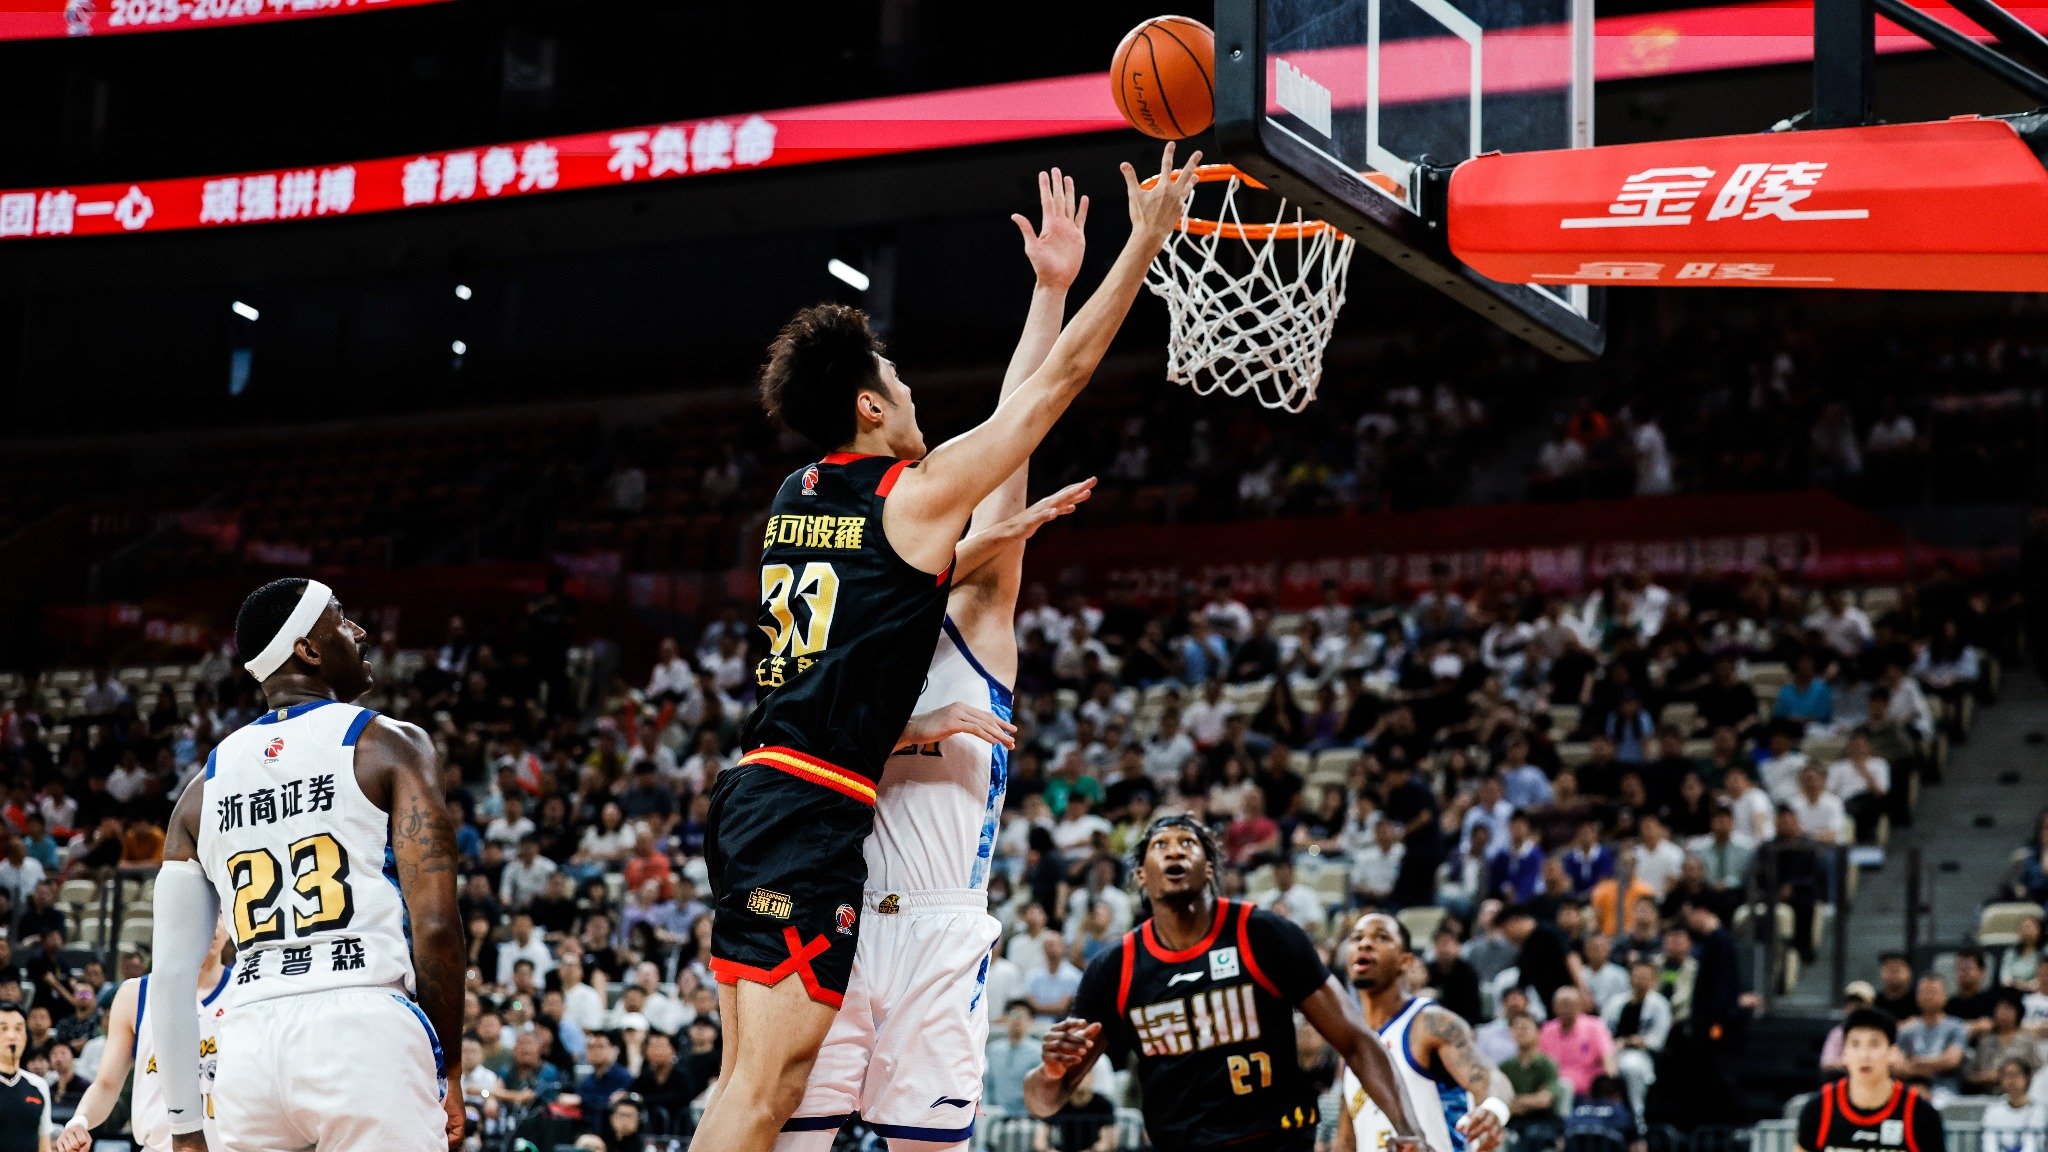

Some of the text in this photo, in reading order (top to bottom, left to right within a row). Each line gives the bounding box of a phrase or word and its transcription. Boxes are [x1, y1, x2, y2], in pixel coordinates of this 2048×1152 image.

[0, 114, 777, 236] 团结一心 顽强拼搏 奋勇争先 不负使命
[1560, 161, 1869, 229] 金陵
[217, 773, 336, 834] 浙商证券
[227, 832, 355, 951] 23
[1129, 984, 1260, 1056] 深圳
[1227, 1051, 1272, 1095] 27
